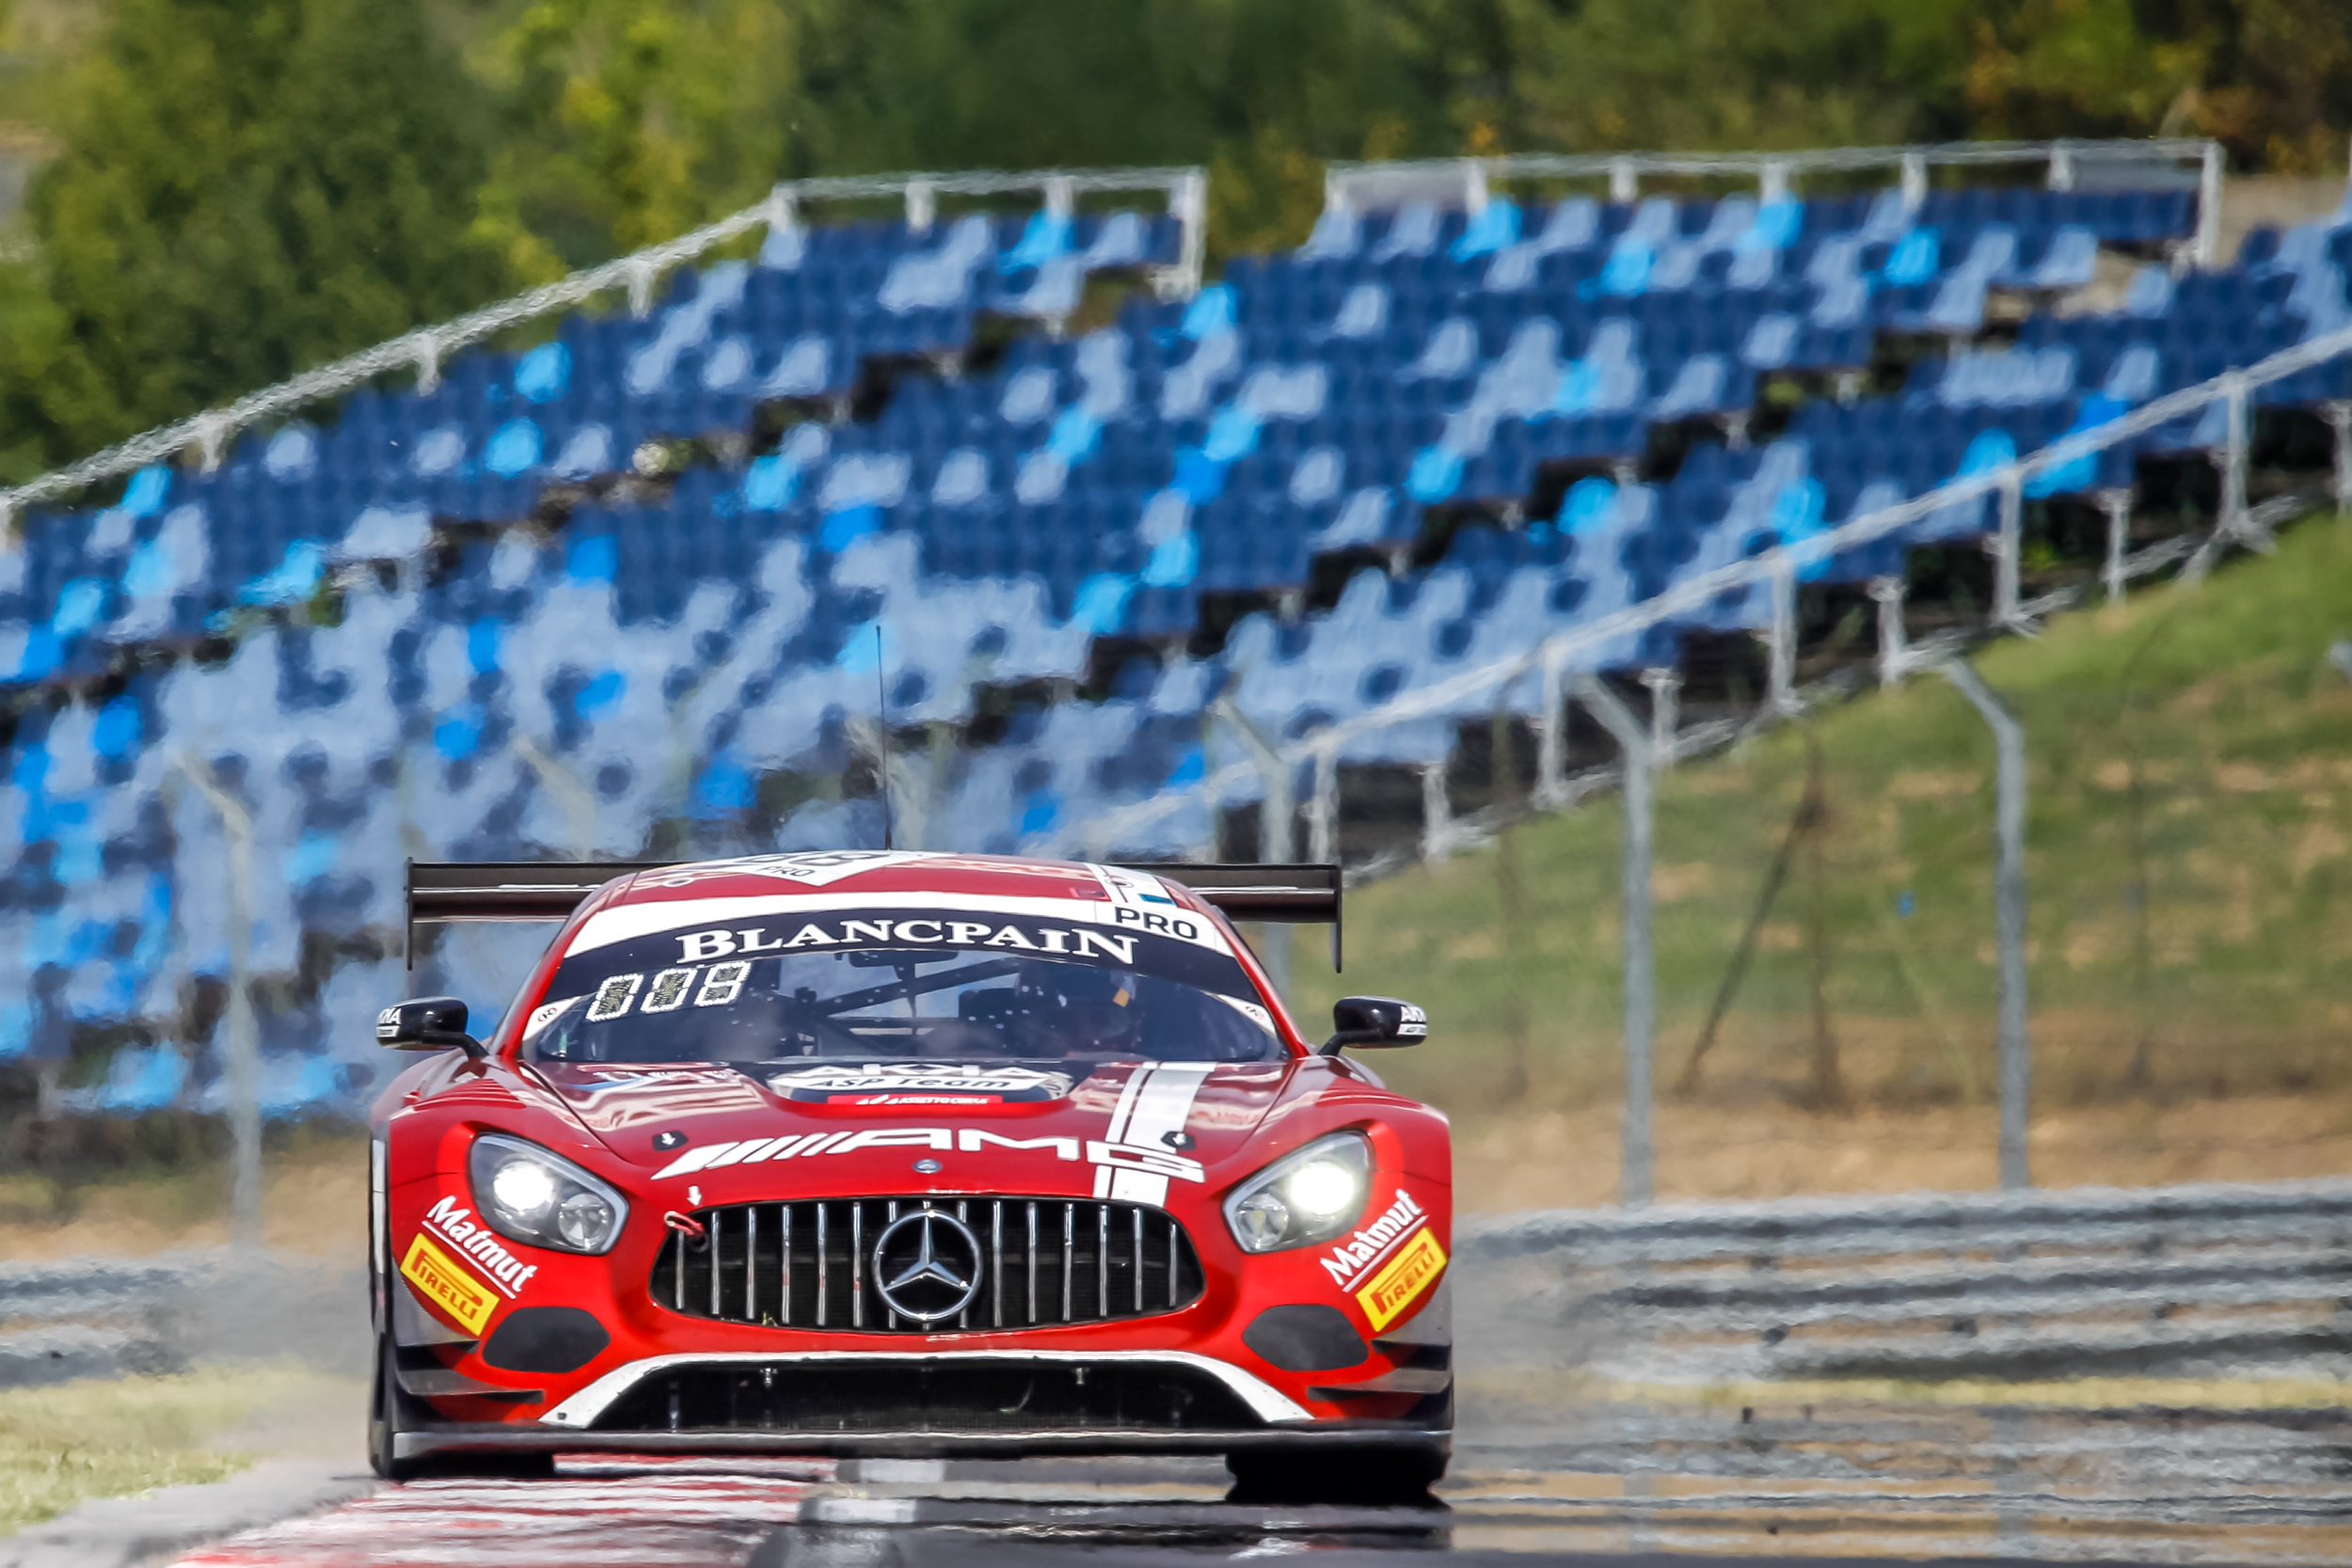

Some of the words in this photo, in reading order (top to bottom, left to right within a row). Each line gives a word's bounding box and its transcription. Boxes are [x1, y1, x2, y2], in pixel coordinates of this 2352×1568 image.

[756, 865, 816, 877] PRO
[675, 919, 1140, 965] BLANCPAIN
[1114, 906, 1199, 941] PRO
[585, 960, 752, 1023] 008
[807, 1078, 885, 1088] ASP
[898, 1077, 1012, 1088] Team
[825, 1127, 1206, 1182] AMG
[426, 1195, 539, 1293] Matmut
[1319, 1188, 1424, 1287] Matmut
[410, 1248, 484, 1321] PIRELLI
[1371, 1242, 1436, 1316] PIRELLI
